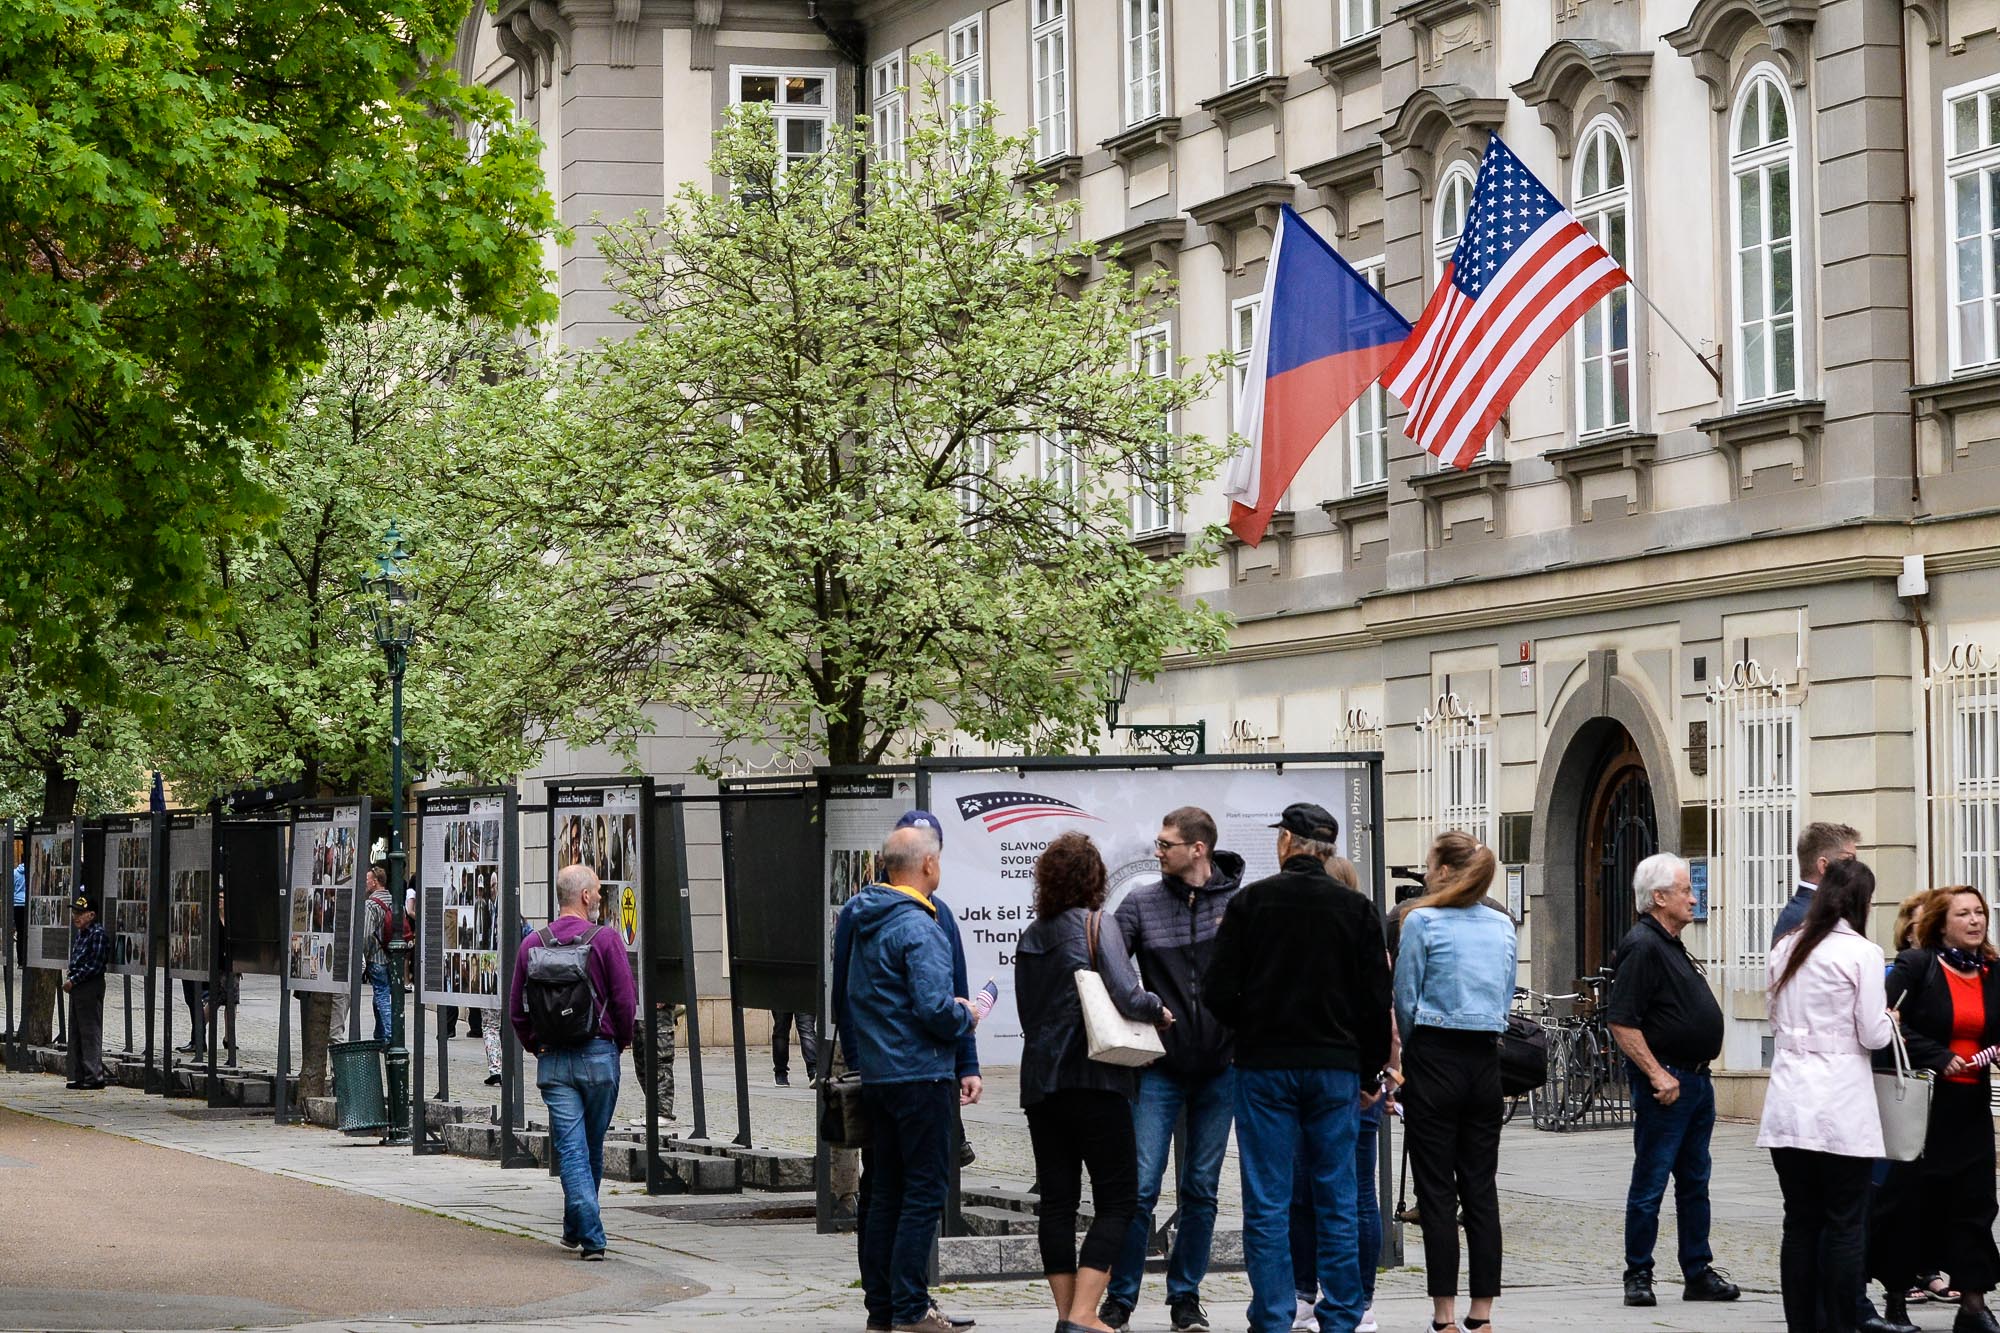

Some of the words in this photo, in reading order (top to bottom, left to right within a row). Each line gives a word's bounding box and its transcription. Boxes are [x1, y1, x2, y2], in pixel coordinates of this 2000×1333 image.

[1350, 777, 1362, 815] Plzeň
[1352, 818, 1362, 863] Město
[958, 906, 992, 921] Jak
[997, 905, 1021, 920] šel
